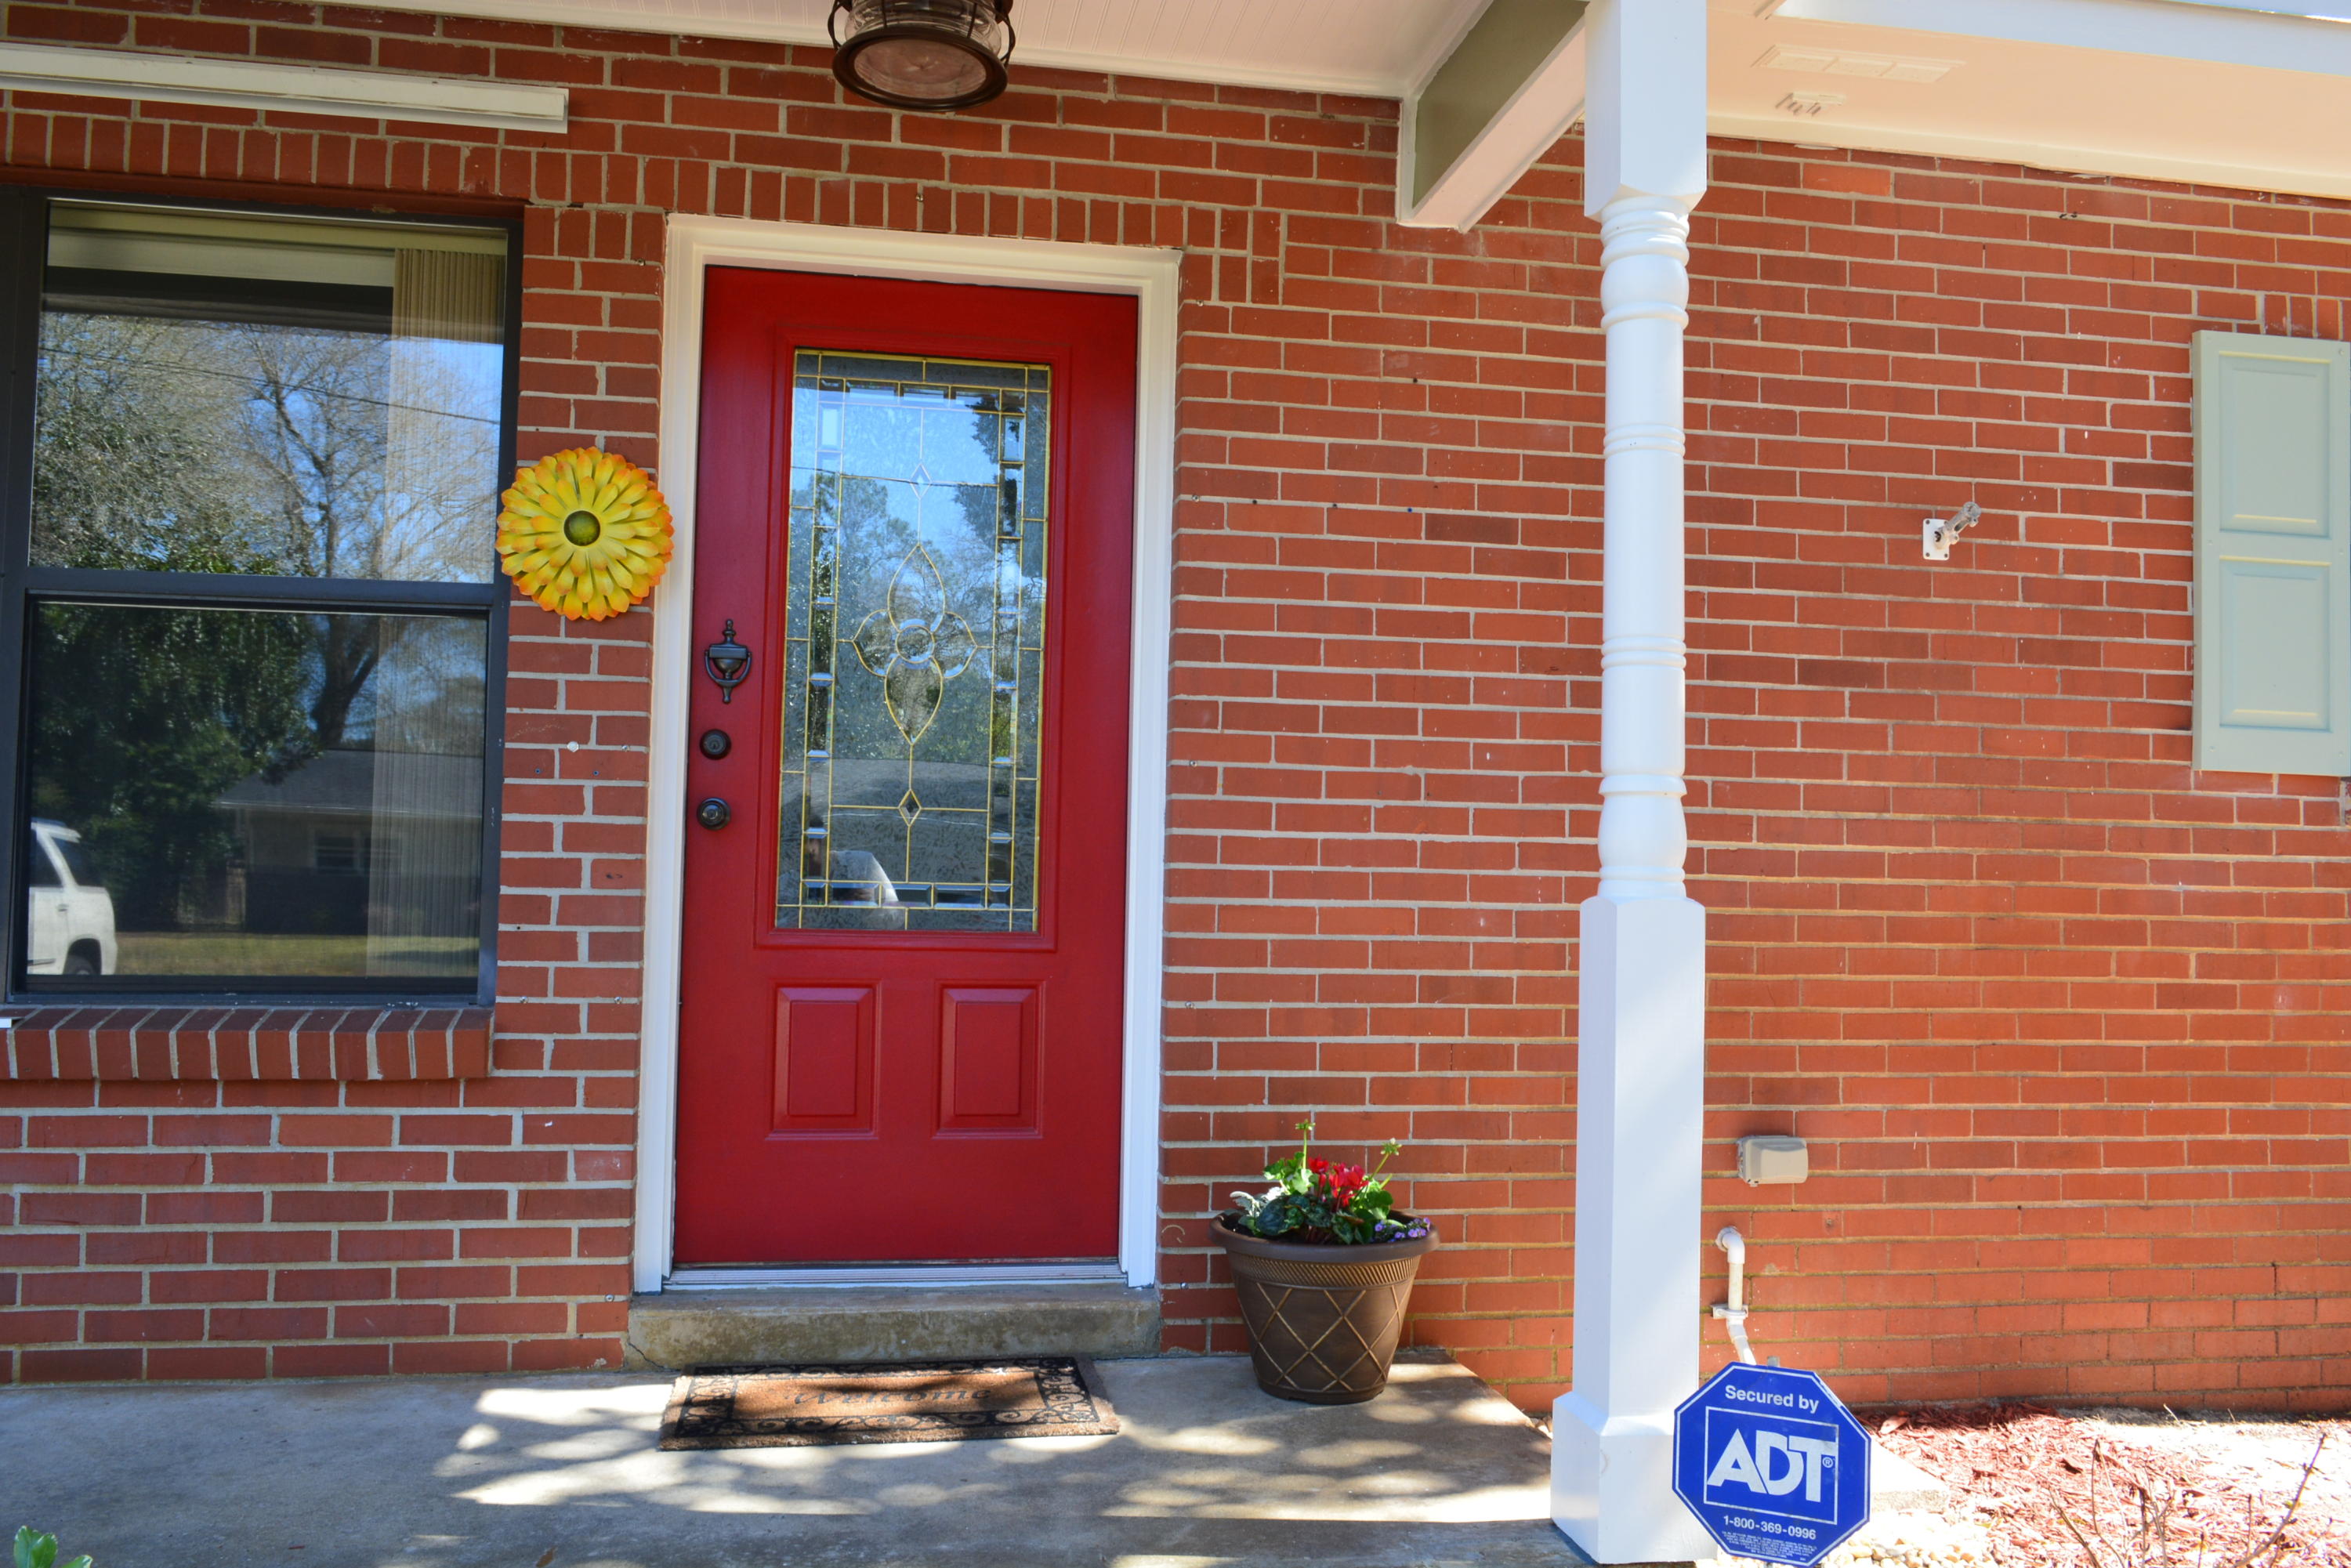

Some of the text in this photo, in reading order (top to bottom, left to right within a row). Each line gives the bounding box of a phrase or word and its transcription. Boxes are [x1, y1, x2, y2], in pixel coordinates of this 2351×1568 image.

[785, 1388, 992, 1405] Welcome
[1725, 1385, 1820, 1414] Secured by
[1723, 1515, 1817, 1540] 1-800-369-0996
